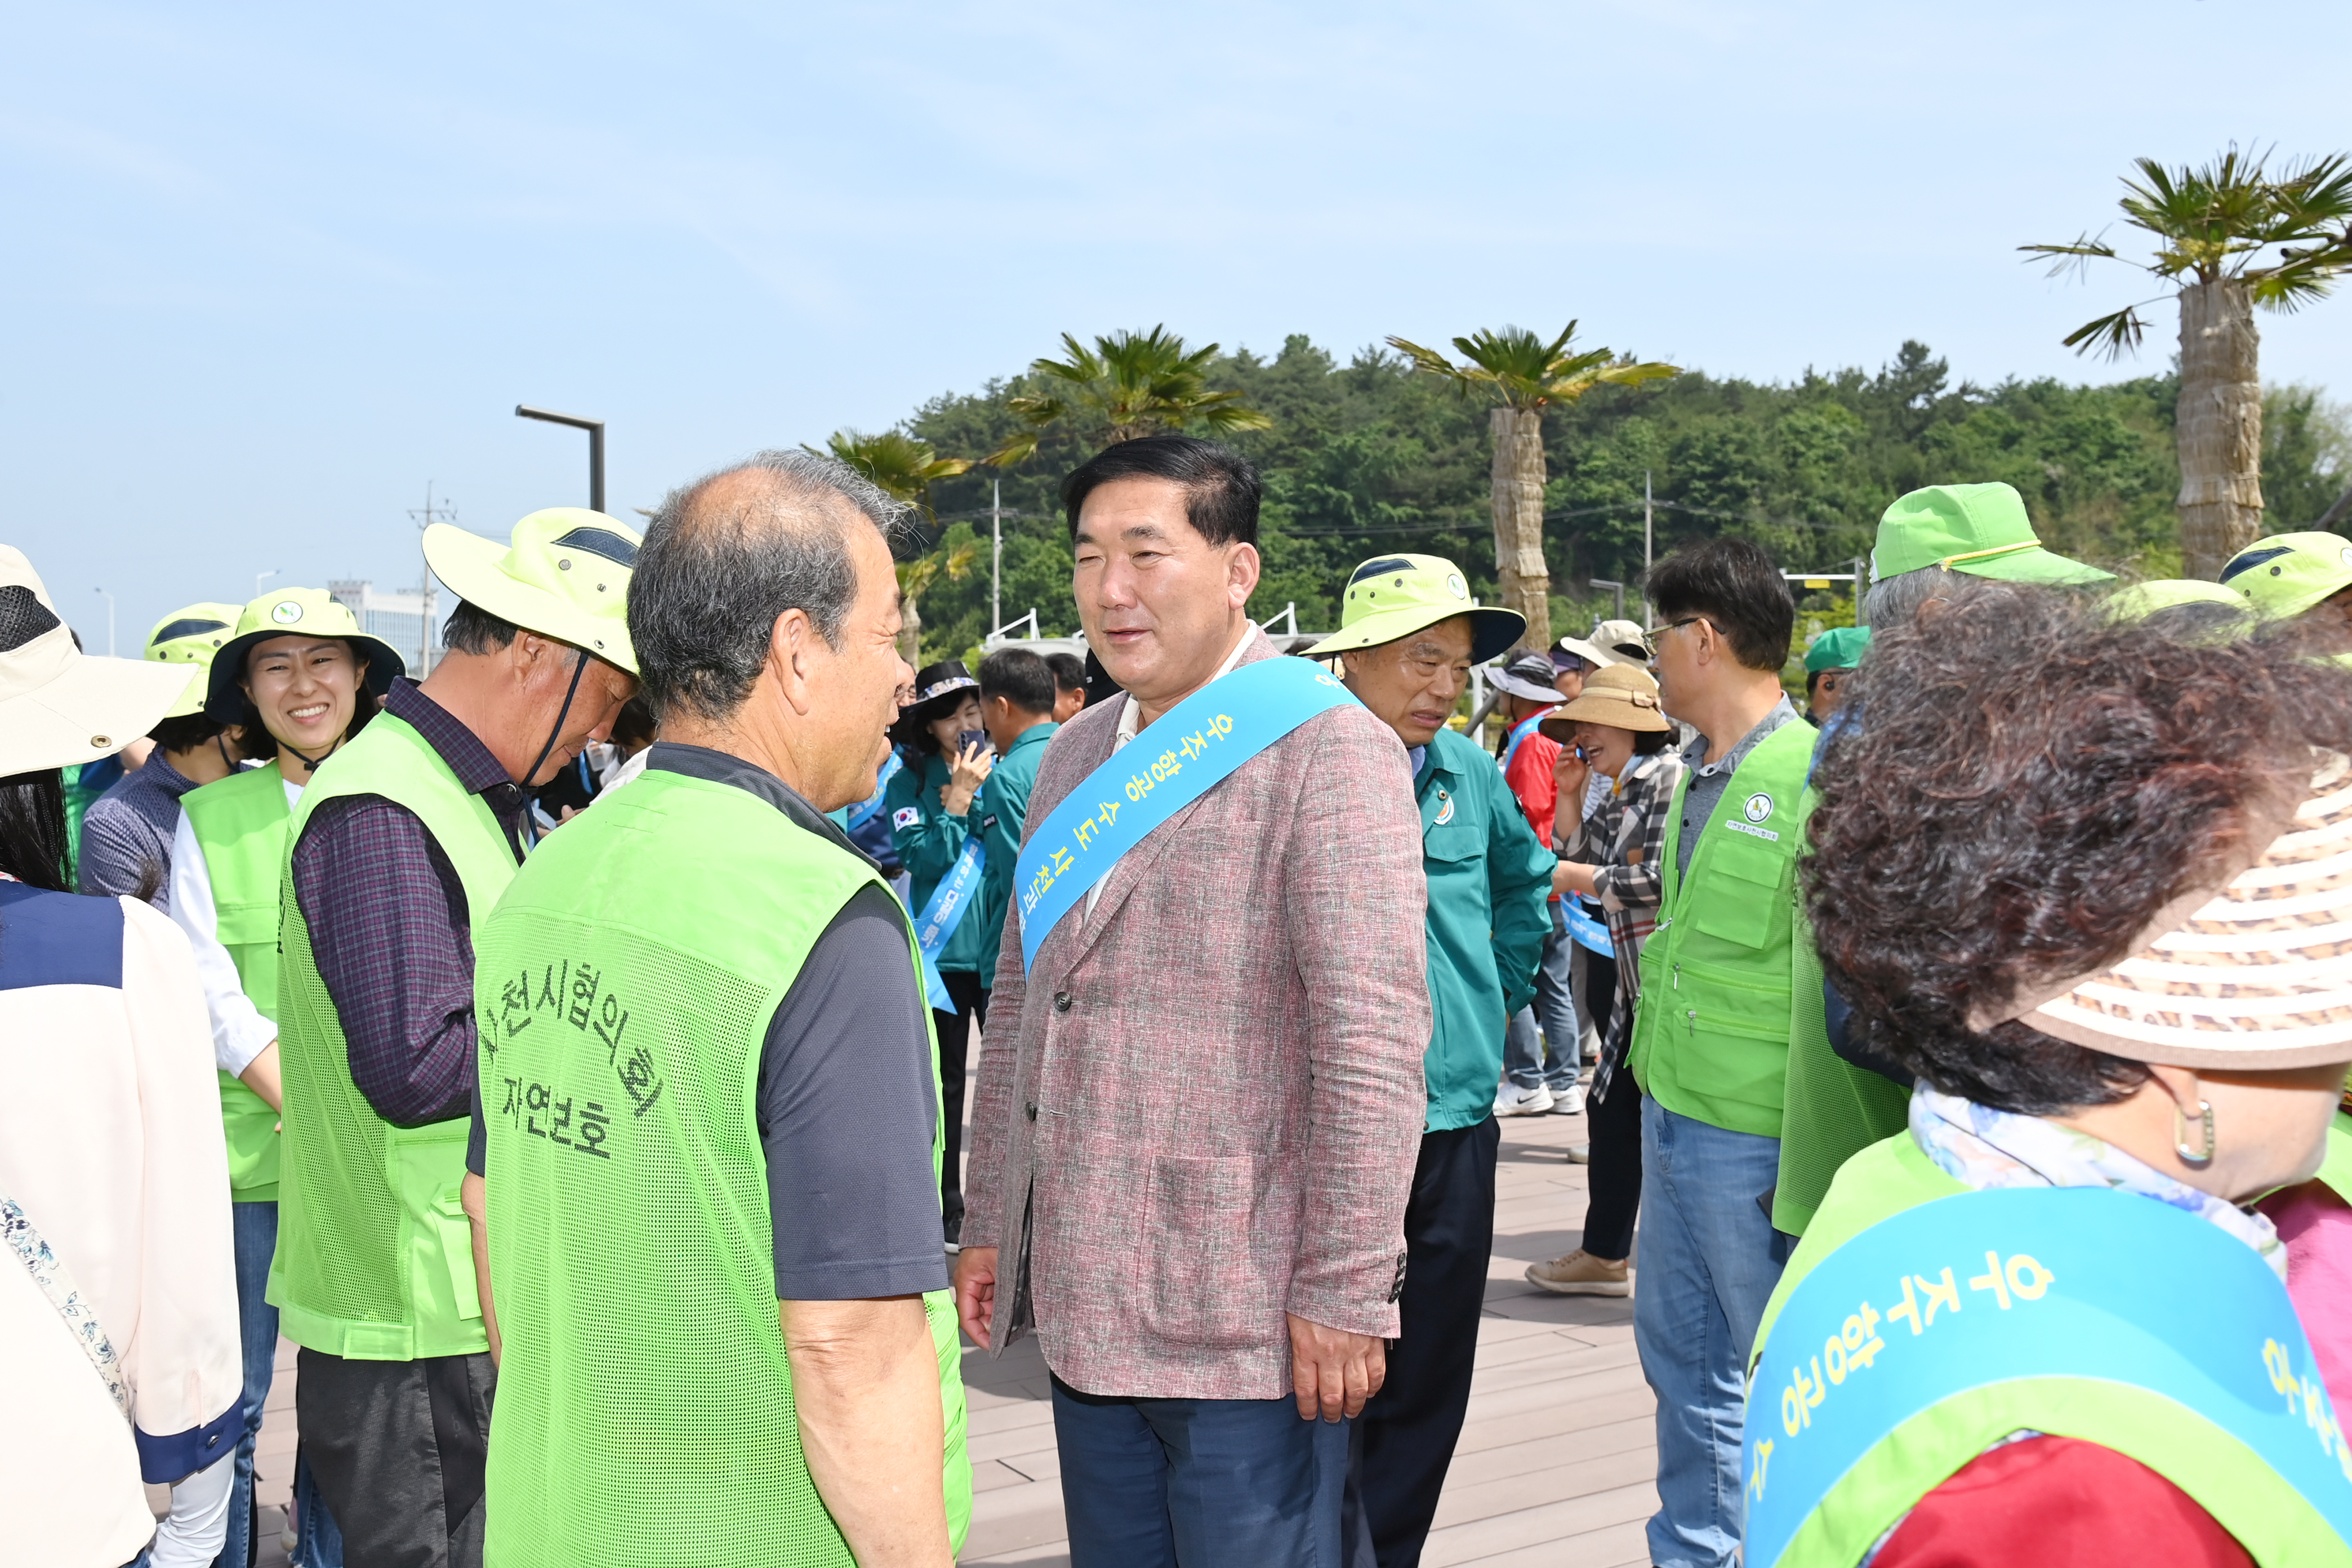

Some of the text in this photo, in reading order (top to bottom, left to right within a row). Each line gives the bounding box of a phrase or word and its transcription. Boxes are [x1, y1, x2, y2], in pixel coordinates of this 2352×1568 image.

[1023, 714, 1233, 916] 우주항공 수도 사천과
[503, 1076, 611, 1160] 자연보호
[1781, 1250, 2055, 1437] 우주항공
